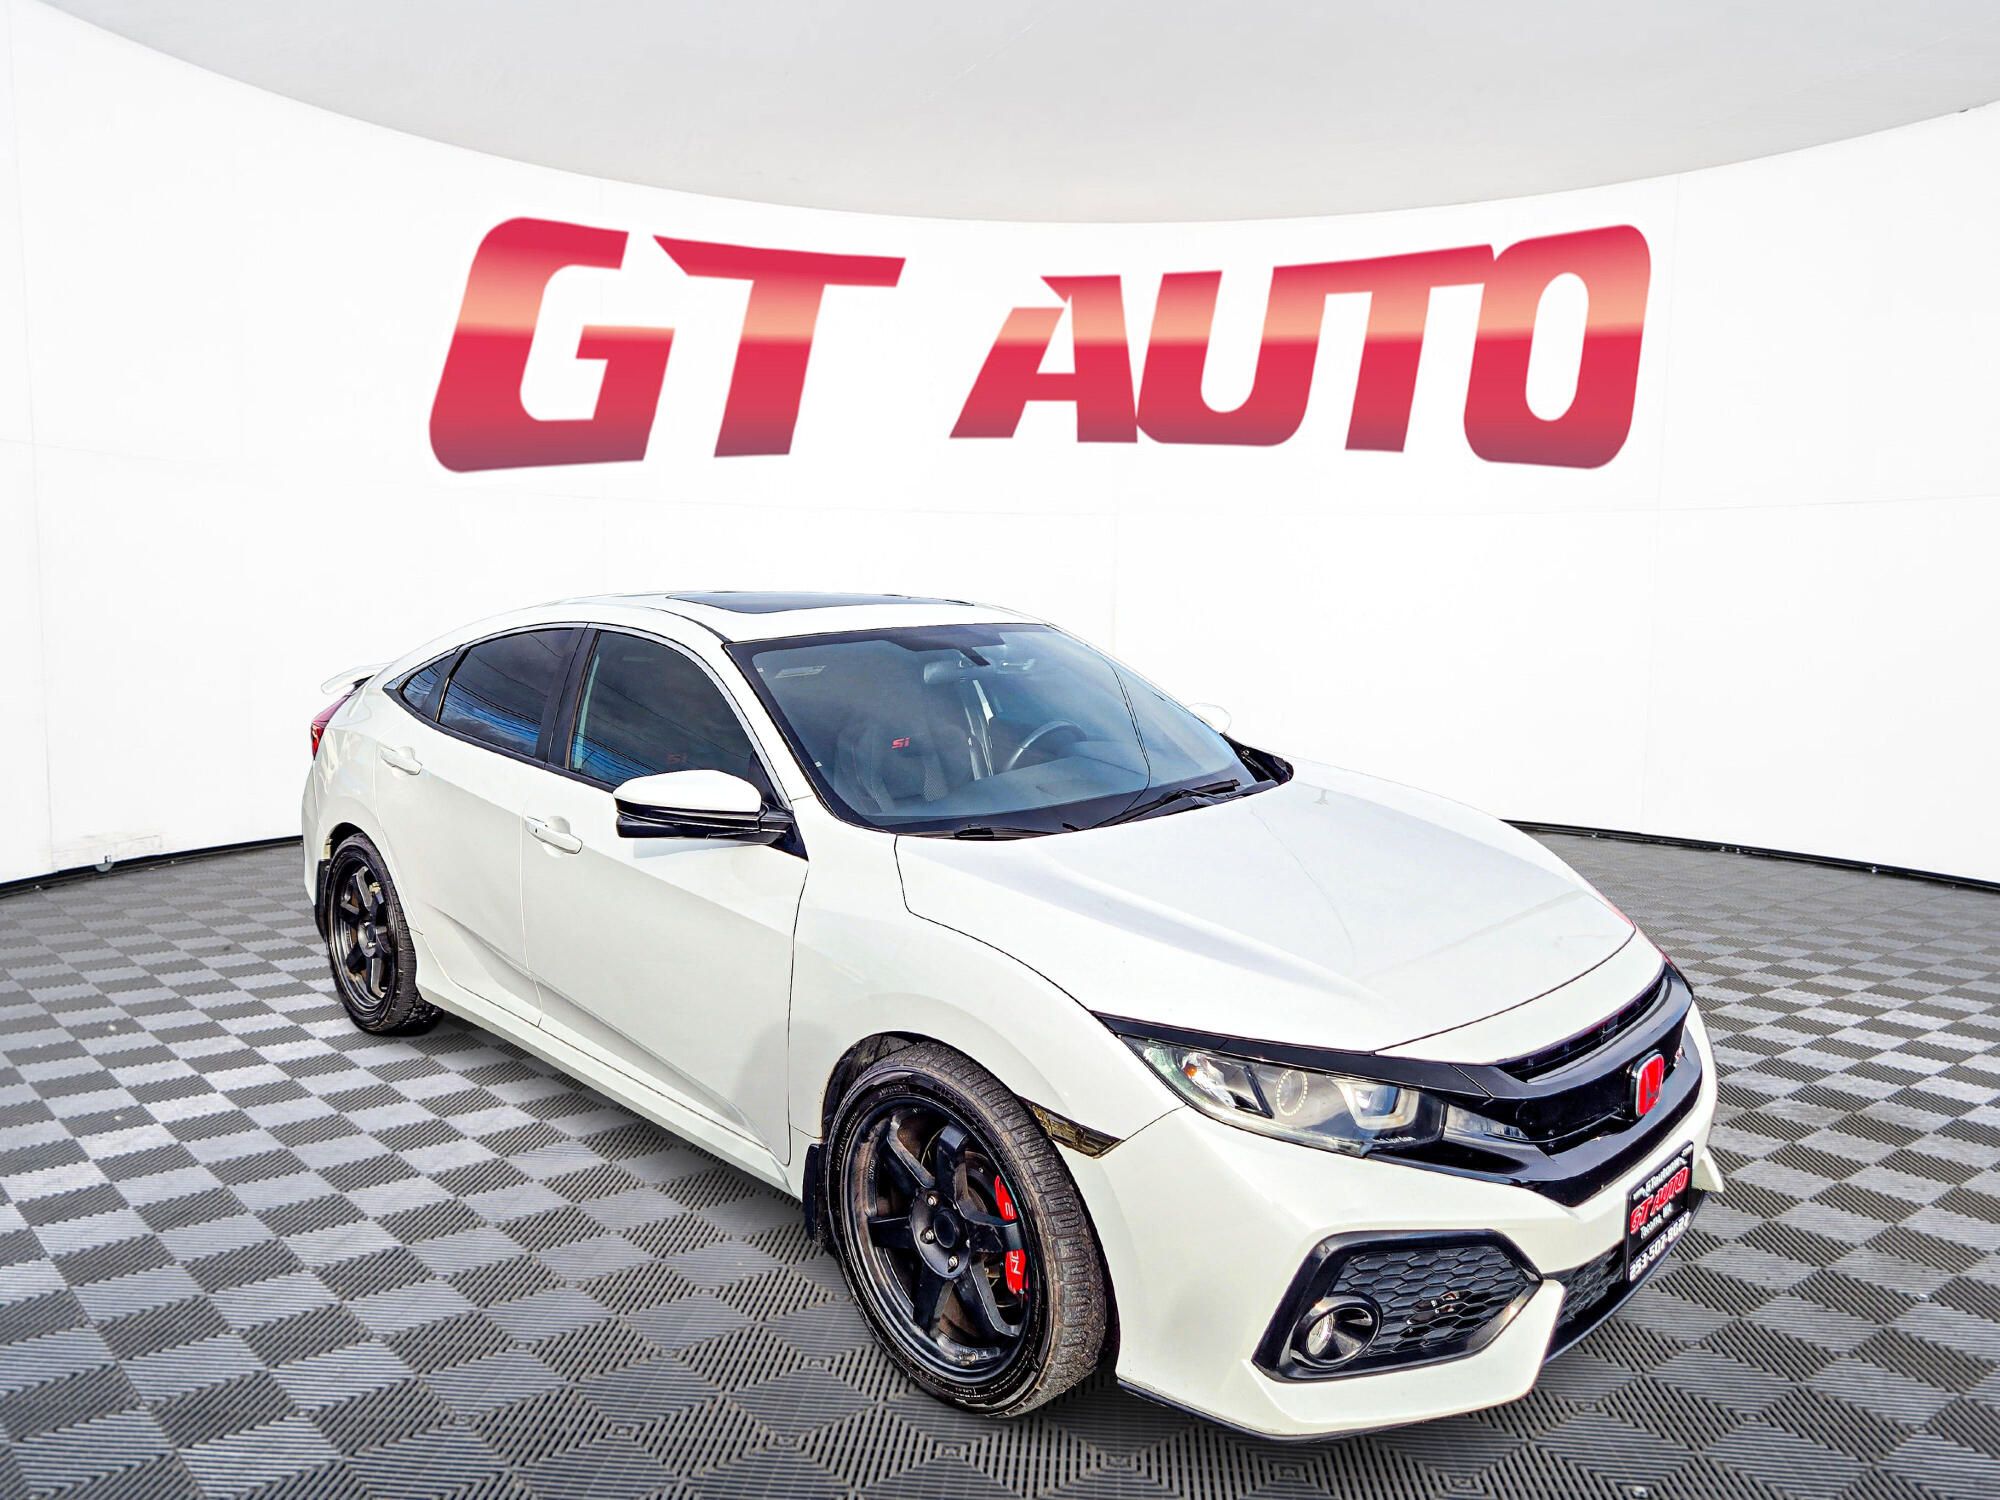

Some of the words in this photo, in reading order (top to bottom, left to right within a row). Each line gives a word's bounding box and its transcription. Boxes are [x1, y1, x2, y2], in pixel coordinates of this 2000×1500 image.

[429, 216, 906, 473] GT
[949, 224, 1652, 469] AUTO
[1630, 1194, 1654, 1235] GT
[1650, 1166, 1690, 1217] AUTO
